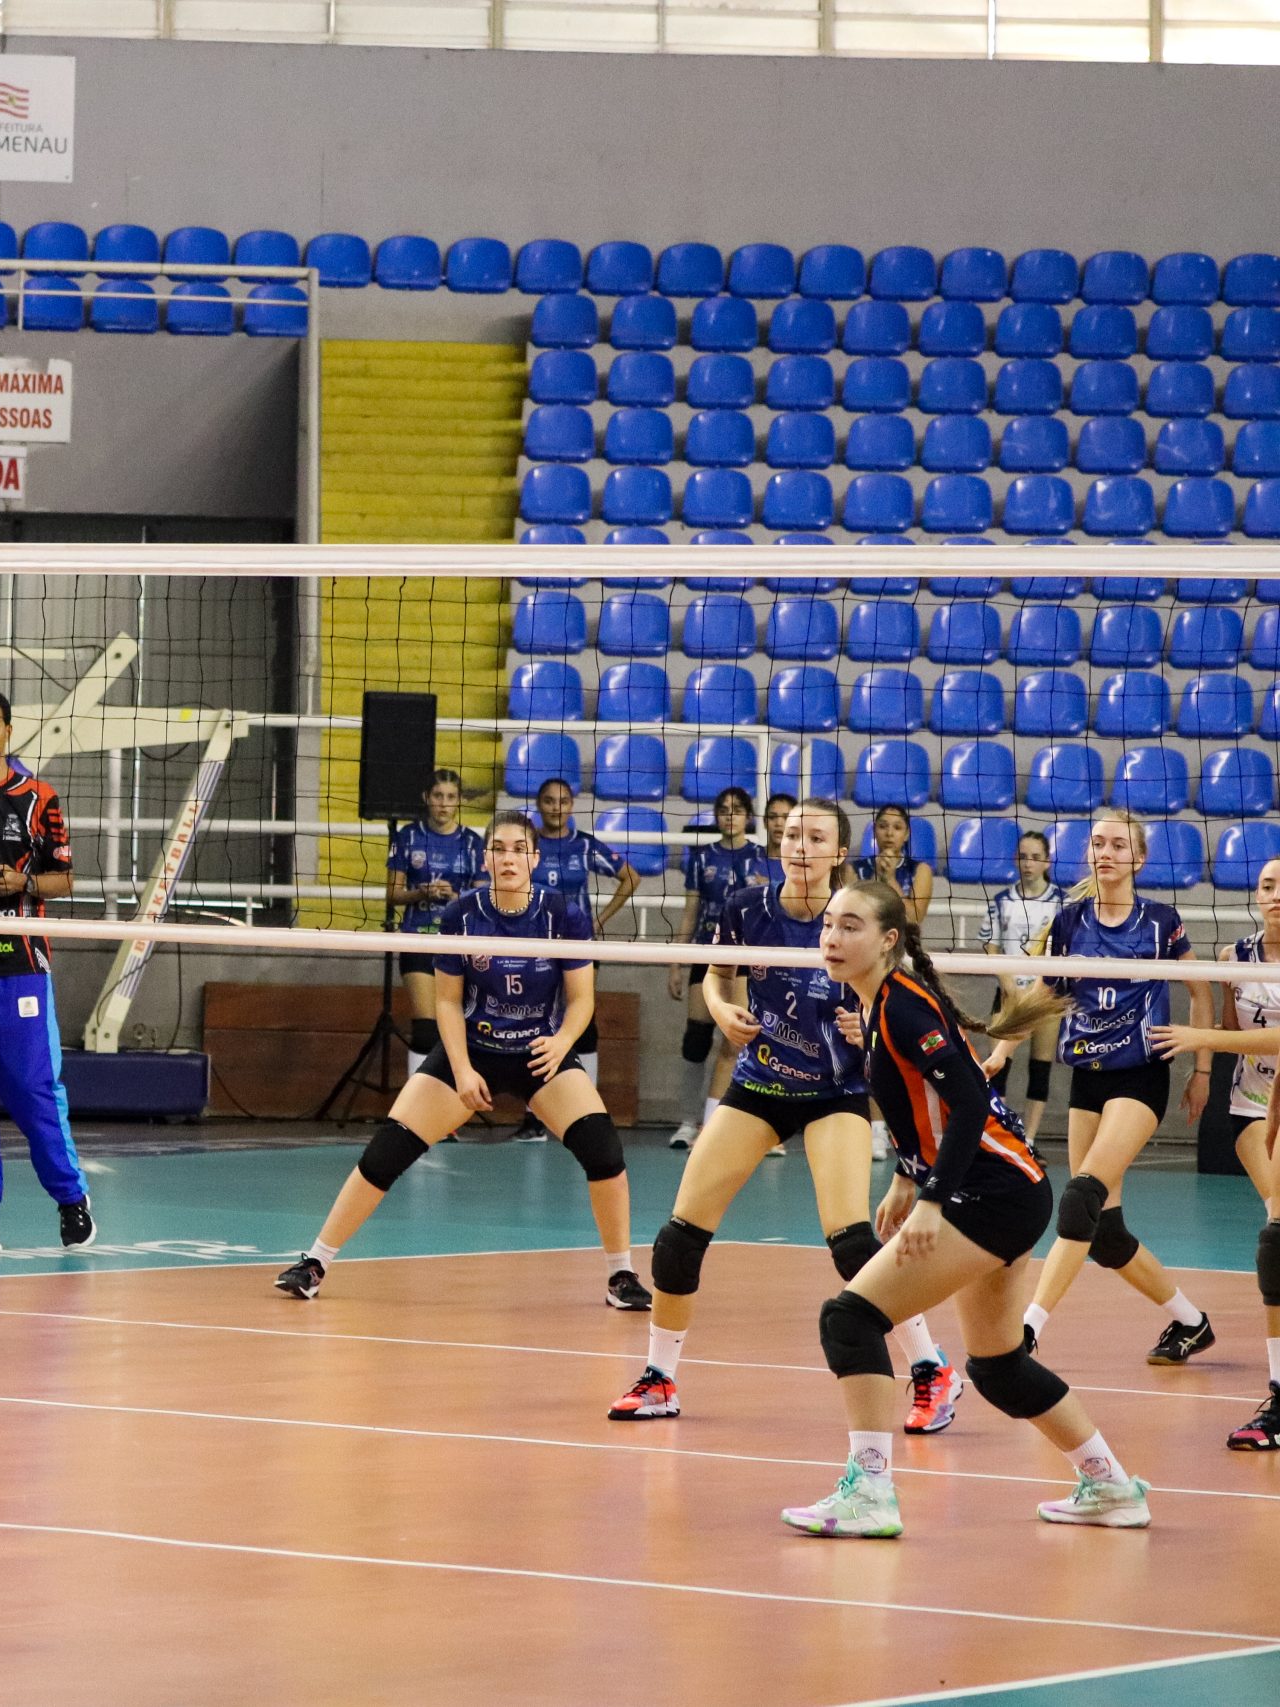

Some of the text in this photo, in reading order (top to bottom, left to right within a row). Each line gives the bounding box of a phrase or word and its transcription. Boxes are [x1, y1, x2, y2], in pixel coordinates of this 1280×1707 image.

[504, 973, 524, 996] 15
[784, 990, 799, 1020] 2
[1097, 985, 1117, 1011] 10
[1252, 1006, 1267, 1028] 4
